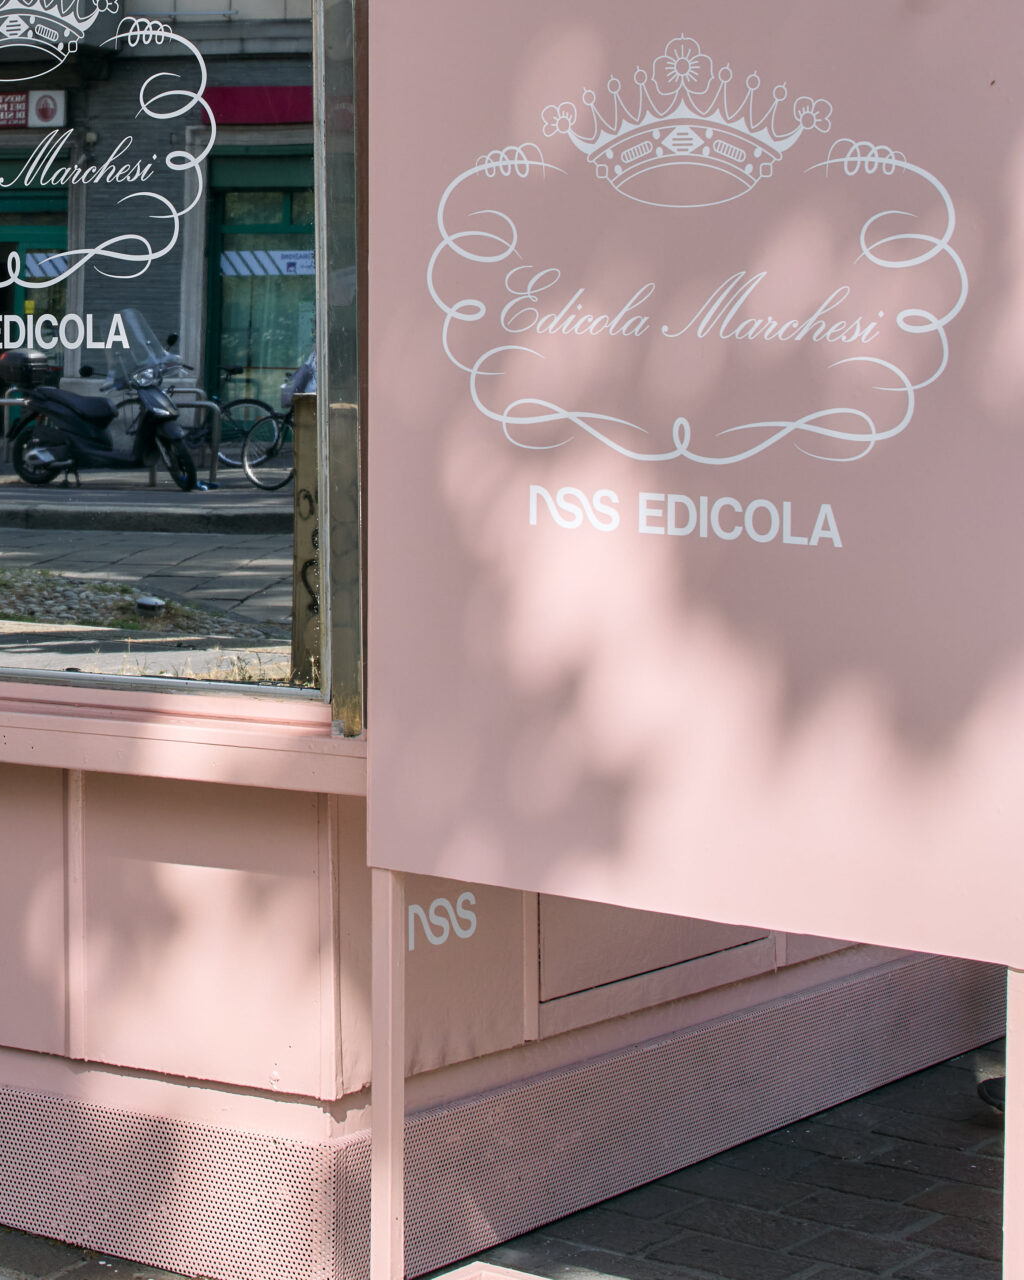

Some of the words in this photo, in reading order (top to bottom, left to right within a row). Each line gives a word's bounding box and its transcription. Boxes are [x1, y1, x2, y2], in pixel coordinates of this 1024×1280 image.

[500, 265, 656, 338] Edicola
[661, 271, 885, 345] Marchesi
[637, 491, 843, 548] EDICOLA
